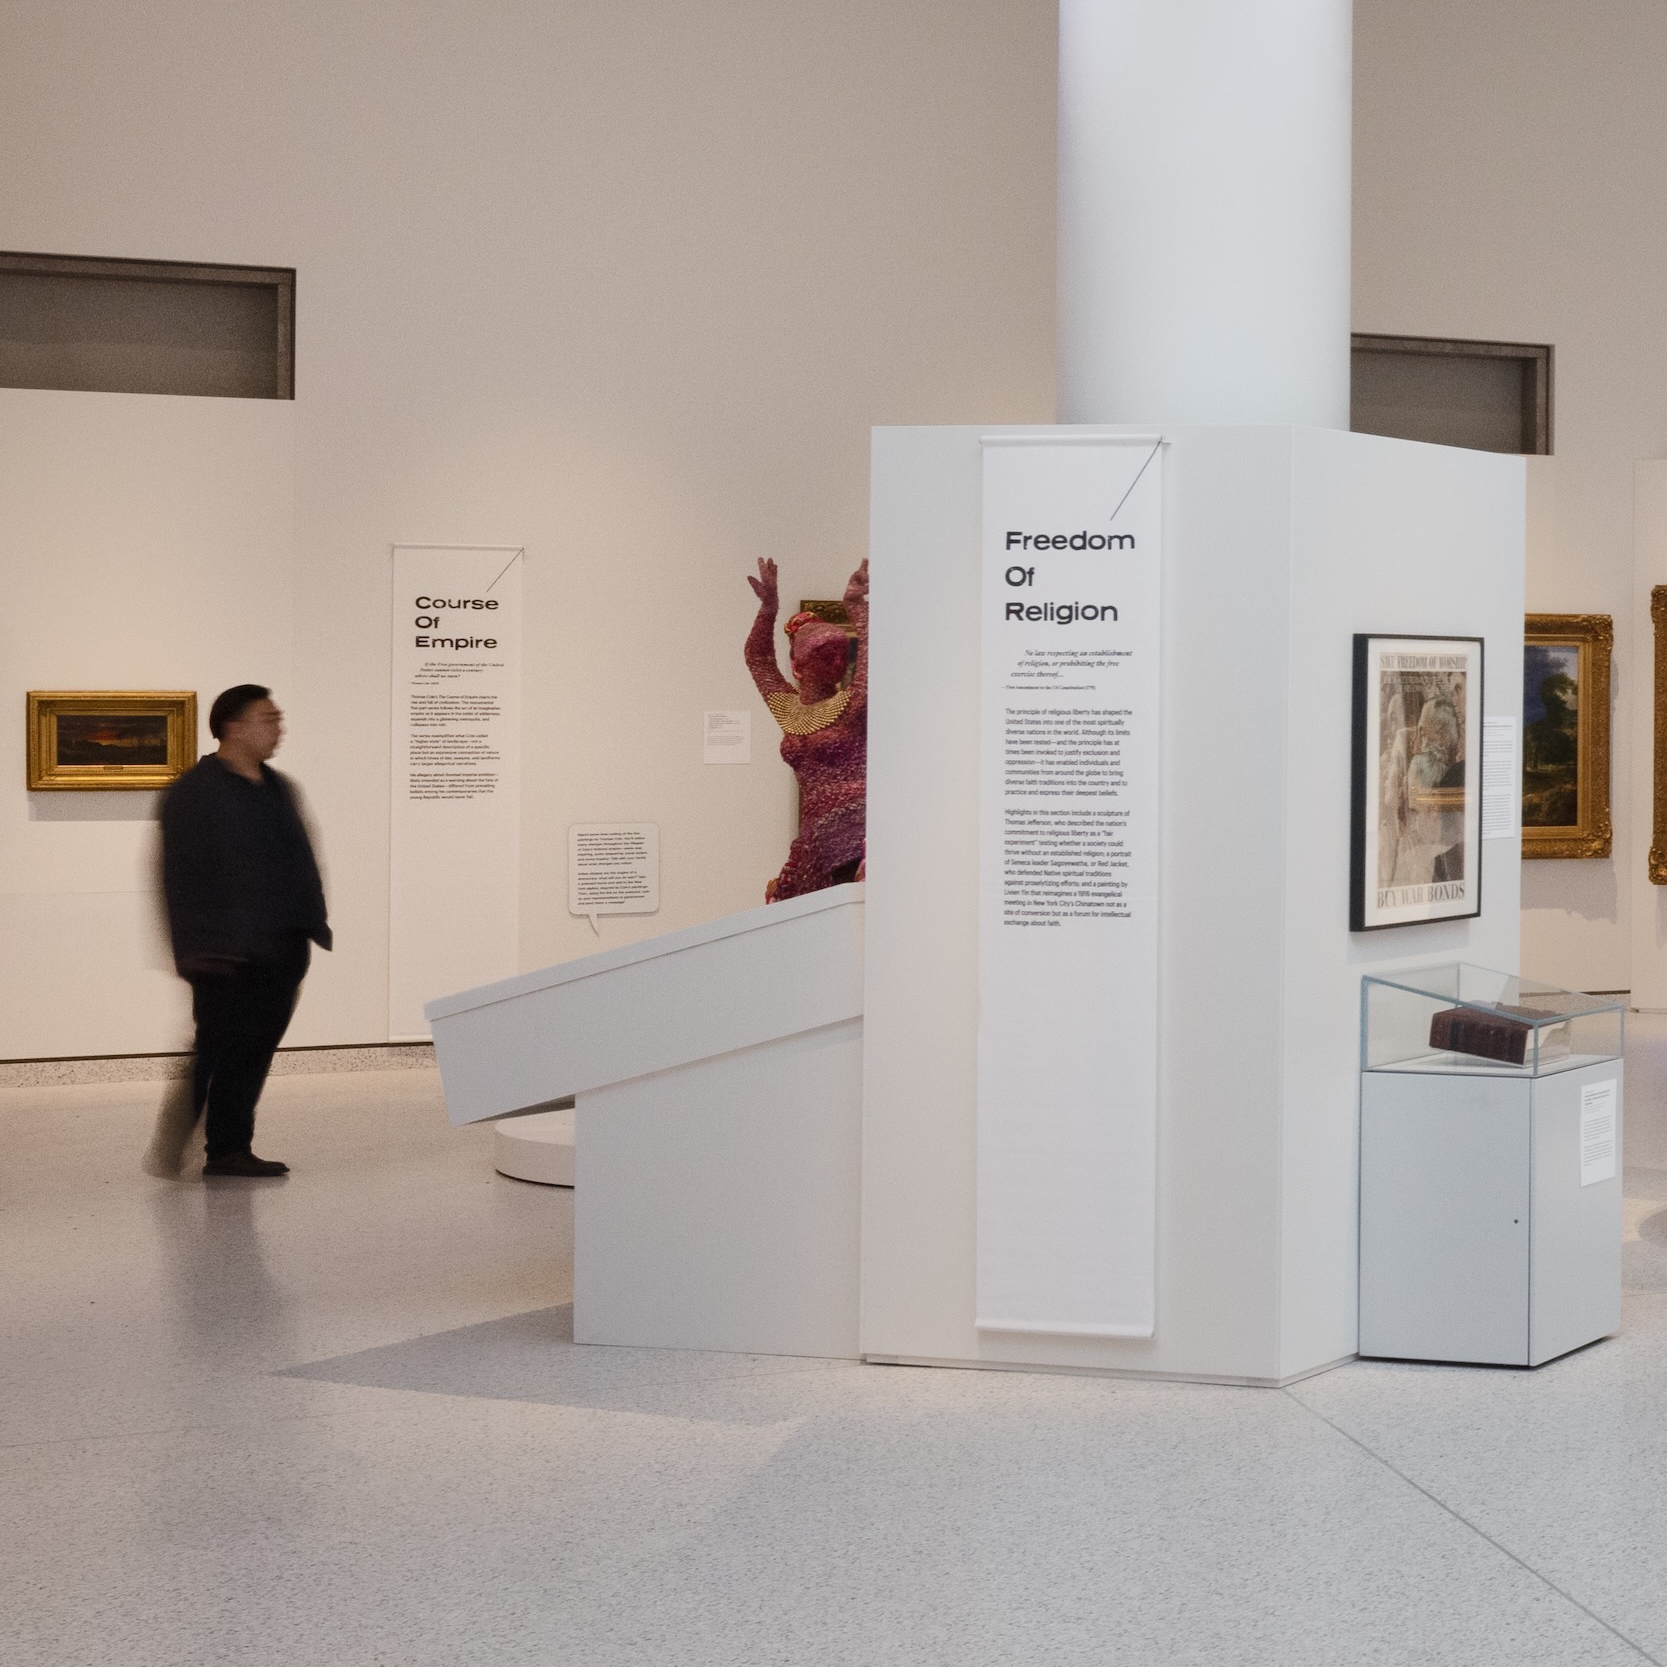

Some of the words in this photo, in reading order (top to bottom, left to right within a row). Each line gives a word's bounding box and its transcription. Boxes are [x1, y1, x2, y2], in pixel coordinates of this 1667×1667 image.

[1006, 531, 1135, 550] Freedom
[1005, 566, 1035, 586] Of
[416, 596, 498, 610] Course
[1006, 602, 1118, 624] Religion
[415, 616, 440, 628] Of
[416, 636, 497, 650] Empire
[1398, 656, 1427, 668] FREEDOM
[1429, 656, 1436, 668] OF
[1005, 809, 1032, 817] Highlights
[1377, 891, 1396, 908] BUY
[1402, 887, 1423, 905] WAR
[1427, 883, 1464, 902] BONDS
